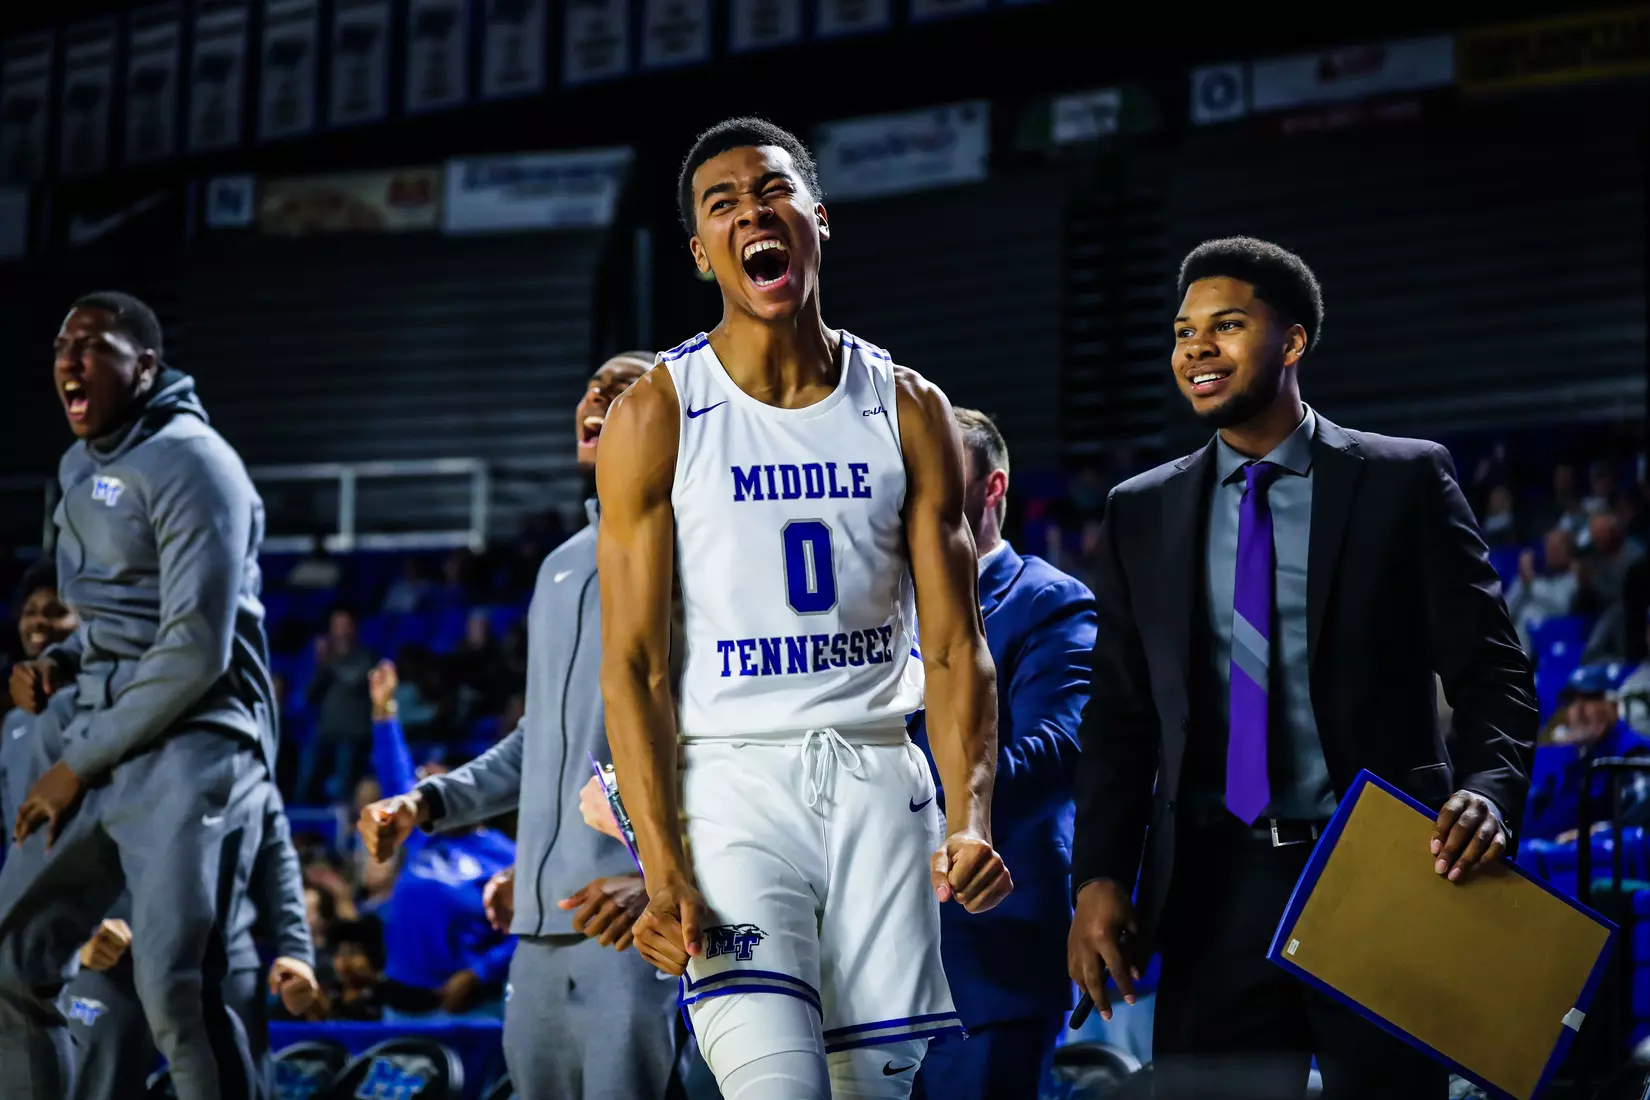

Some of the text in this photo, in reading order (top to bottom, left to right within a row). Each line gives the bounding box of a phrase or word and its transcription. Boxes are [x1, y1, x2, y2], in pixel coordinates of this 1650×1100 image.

[730, 461, 873, 502] MIDDLE
[779, 517, 839, 617] 0
[716, 625, 894, 678] TENNESSEE
[705, 926, 762, 961] MT
